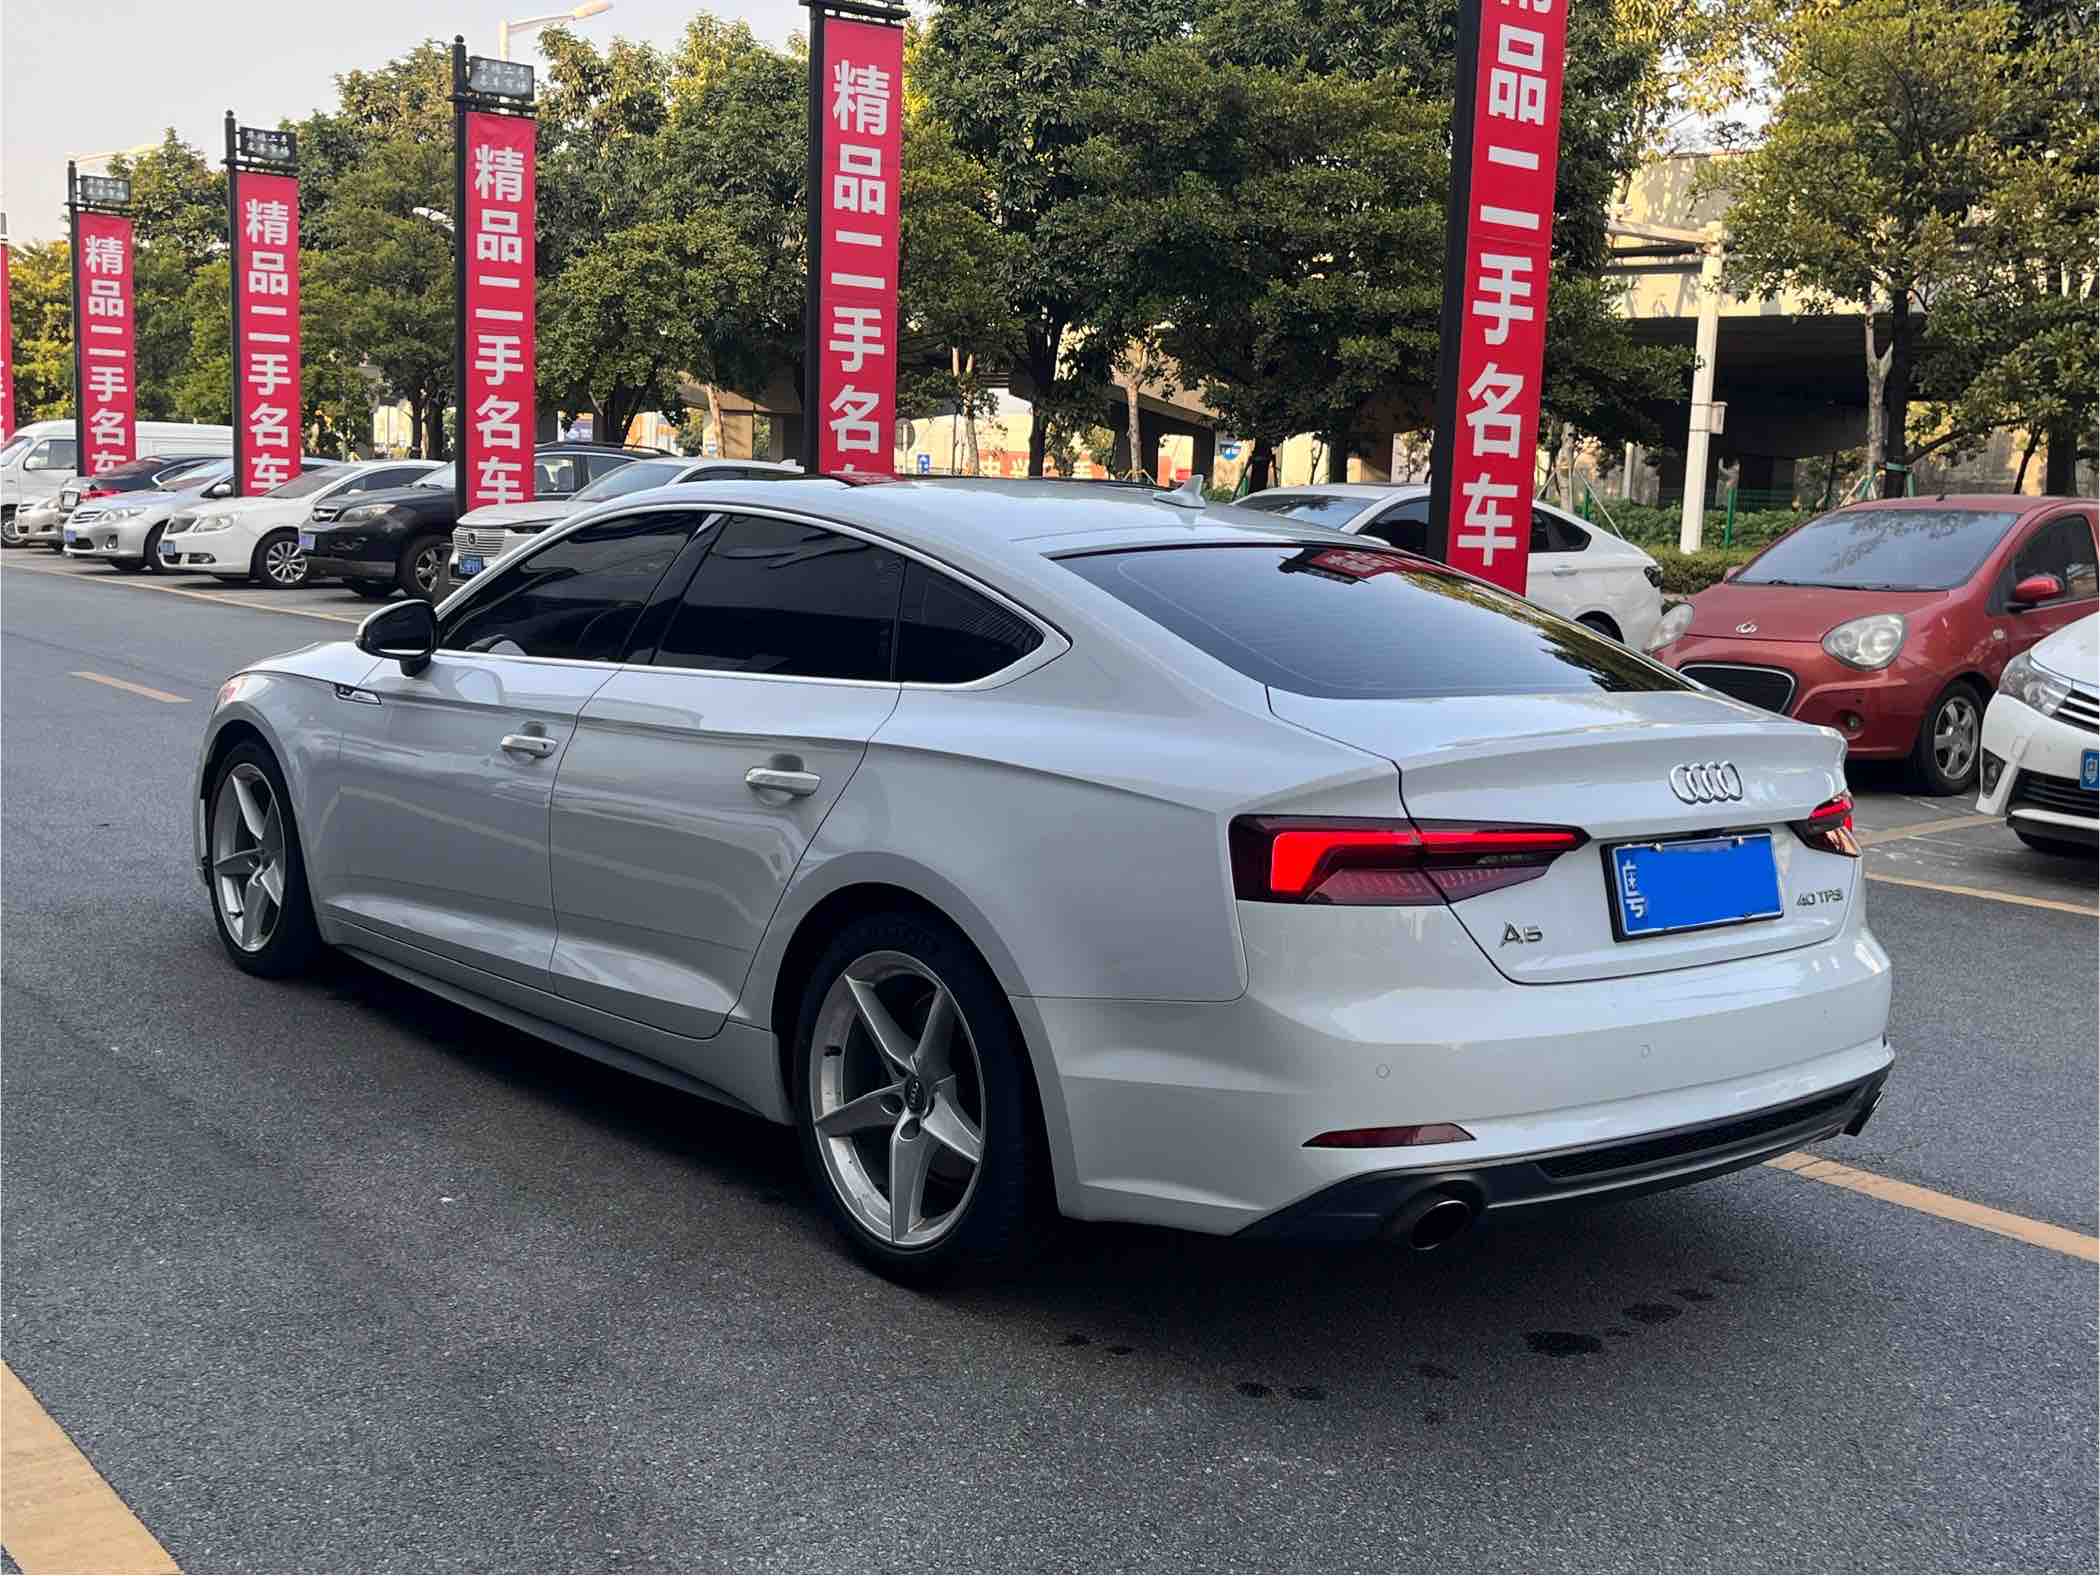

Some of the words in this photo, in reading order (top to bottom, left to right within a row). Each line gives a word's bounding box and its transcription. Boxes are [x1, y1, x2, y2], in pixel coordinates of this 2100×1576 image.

[246, 198, 291, 493] 精品二手名车
[474, 144, 525, 504] 精品二手名车
[829, 59, 890, 473] 精品二手名
[1457, 0, 1553, 566] 品二手名车
[1499, 920, 1544, 948] A5
